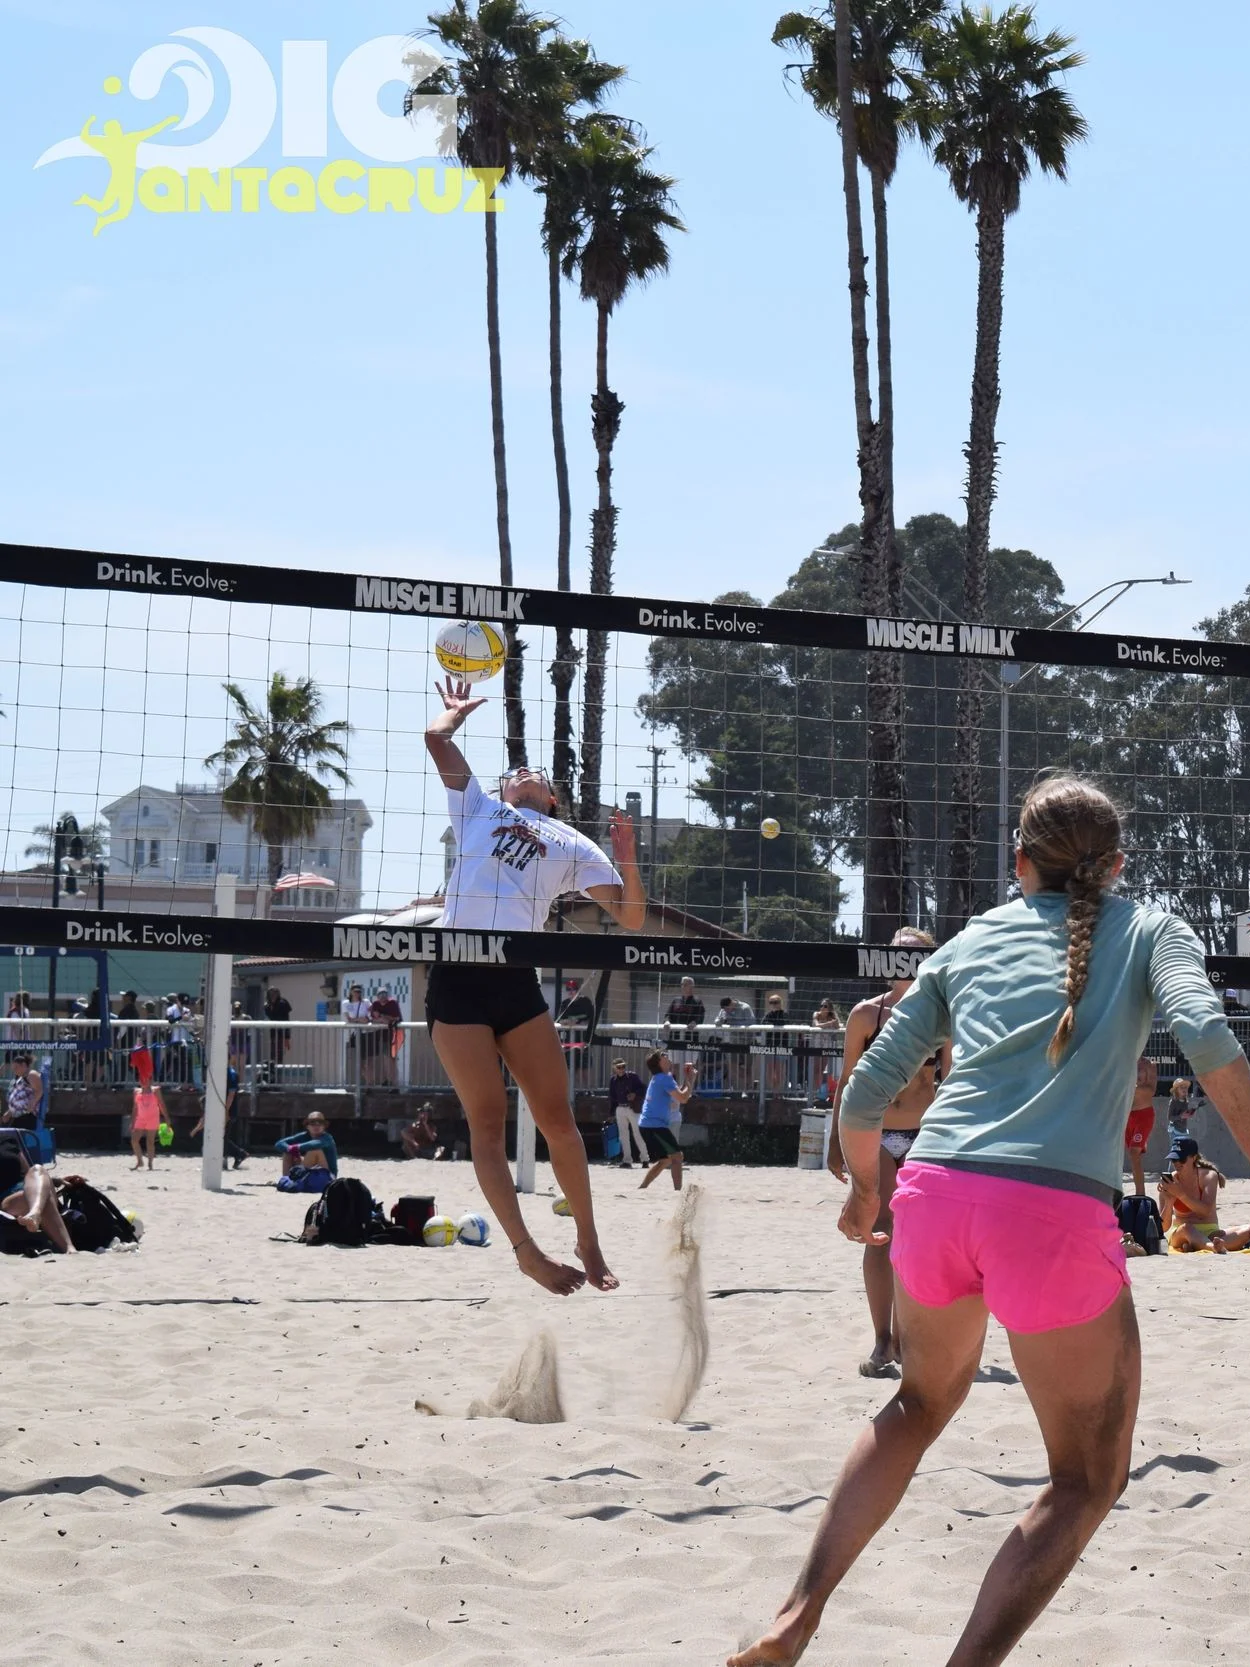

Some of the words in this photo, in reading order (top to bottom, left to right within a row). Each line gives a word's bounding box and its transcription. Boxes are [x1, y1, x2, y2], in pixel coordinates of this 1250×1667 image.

[98, 562, 167, 585] Drink.
[355, 577, 457, 615] MUSCLE
[463, 583, 525, 620] MILK
[639, 608, 700, 629] Drink.
[866, 619, 954, 653] MUSCLE
[959, 624, 1016, 656] MILK
[1118, 643, 1169, 664] Drink.
[491, 847, 531, 872] MAN
[67, 921, 137, 943] Drink.
[334, 927, 436, 961] MUSCLE
[442, 933, 506, 963] MILK
[625, 946, 687, 965] Drink.
[750, 1046, 776, 1055] MUSCLE
[776, 1047, 793, 1056] MILK
